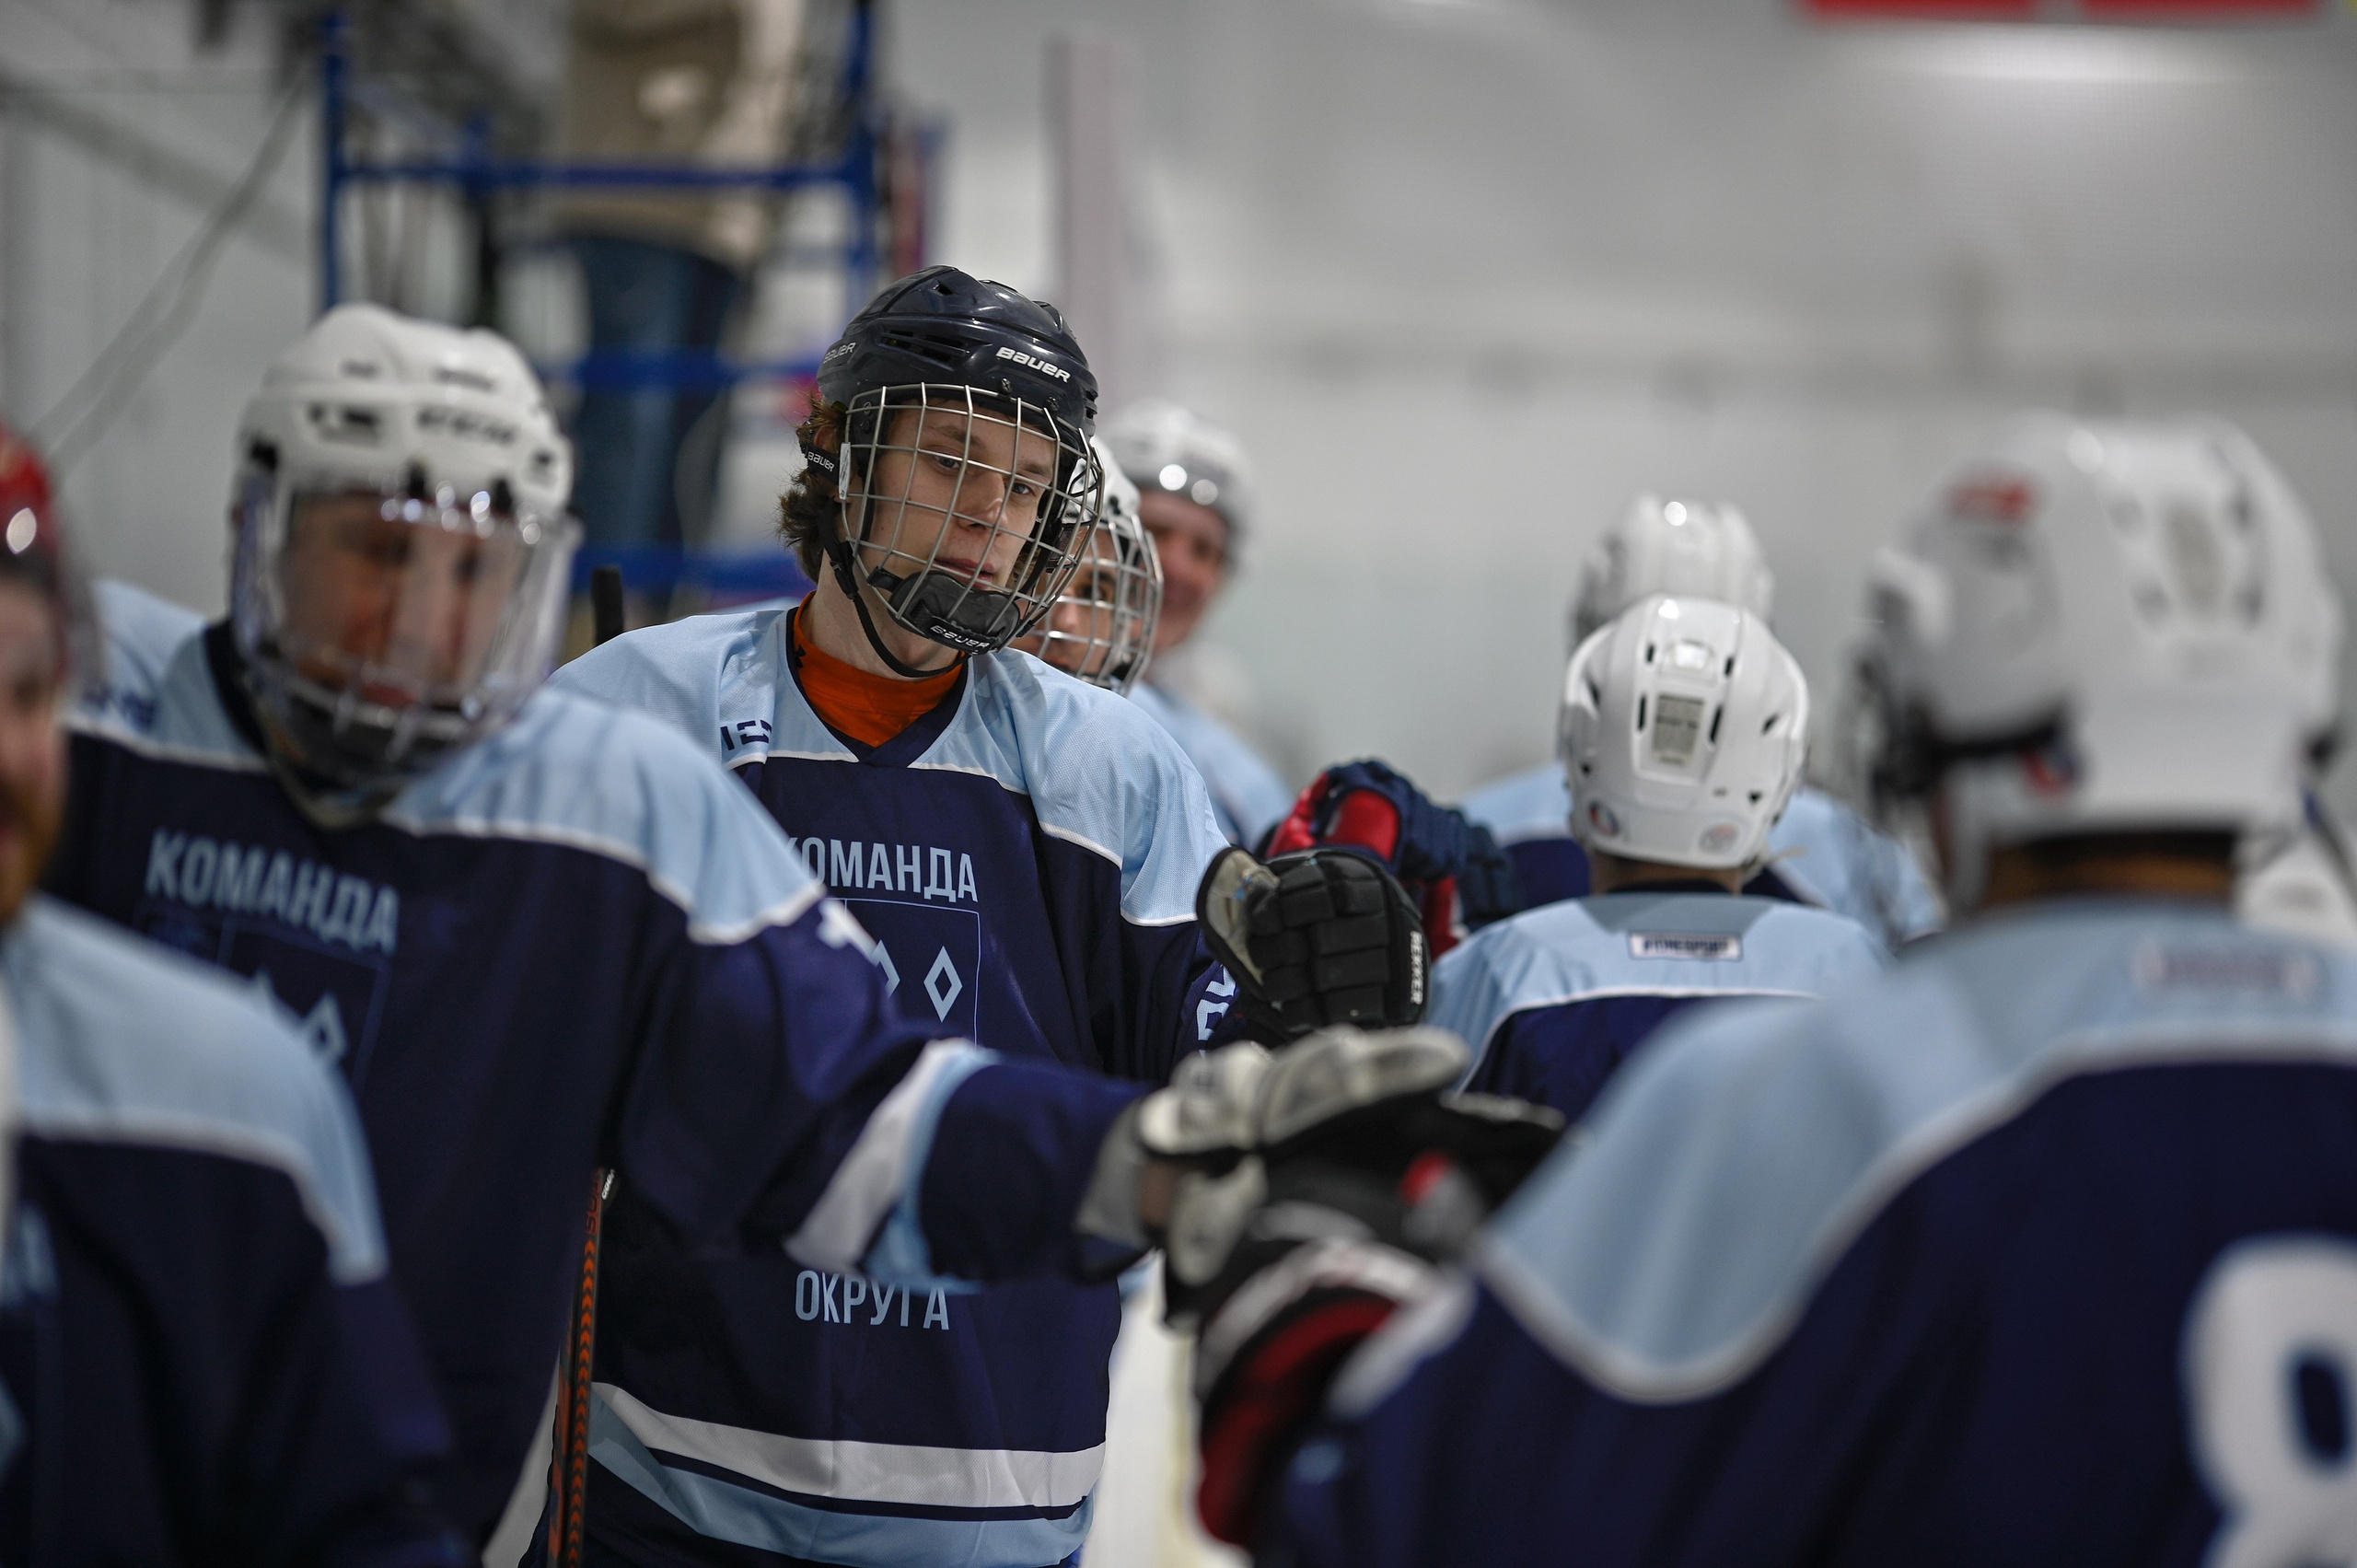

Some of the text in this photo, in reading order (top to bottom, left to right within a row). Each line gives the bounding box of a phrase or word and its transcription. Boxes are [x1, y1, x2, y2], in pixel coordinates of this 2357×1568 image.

[995, 346, 1071, 383] BAUER
[807, 451, 835, 472] BAUER
[144, 828, 400, 955] КОМАНДА
[1410, 930, 1423, 1005] REKKER
